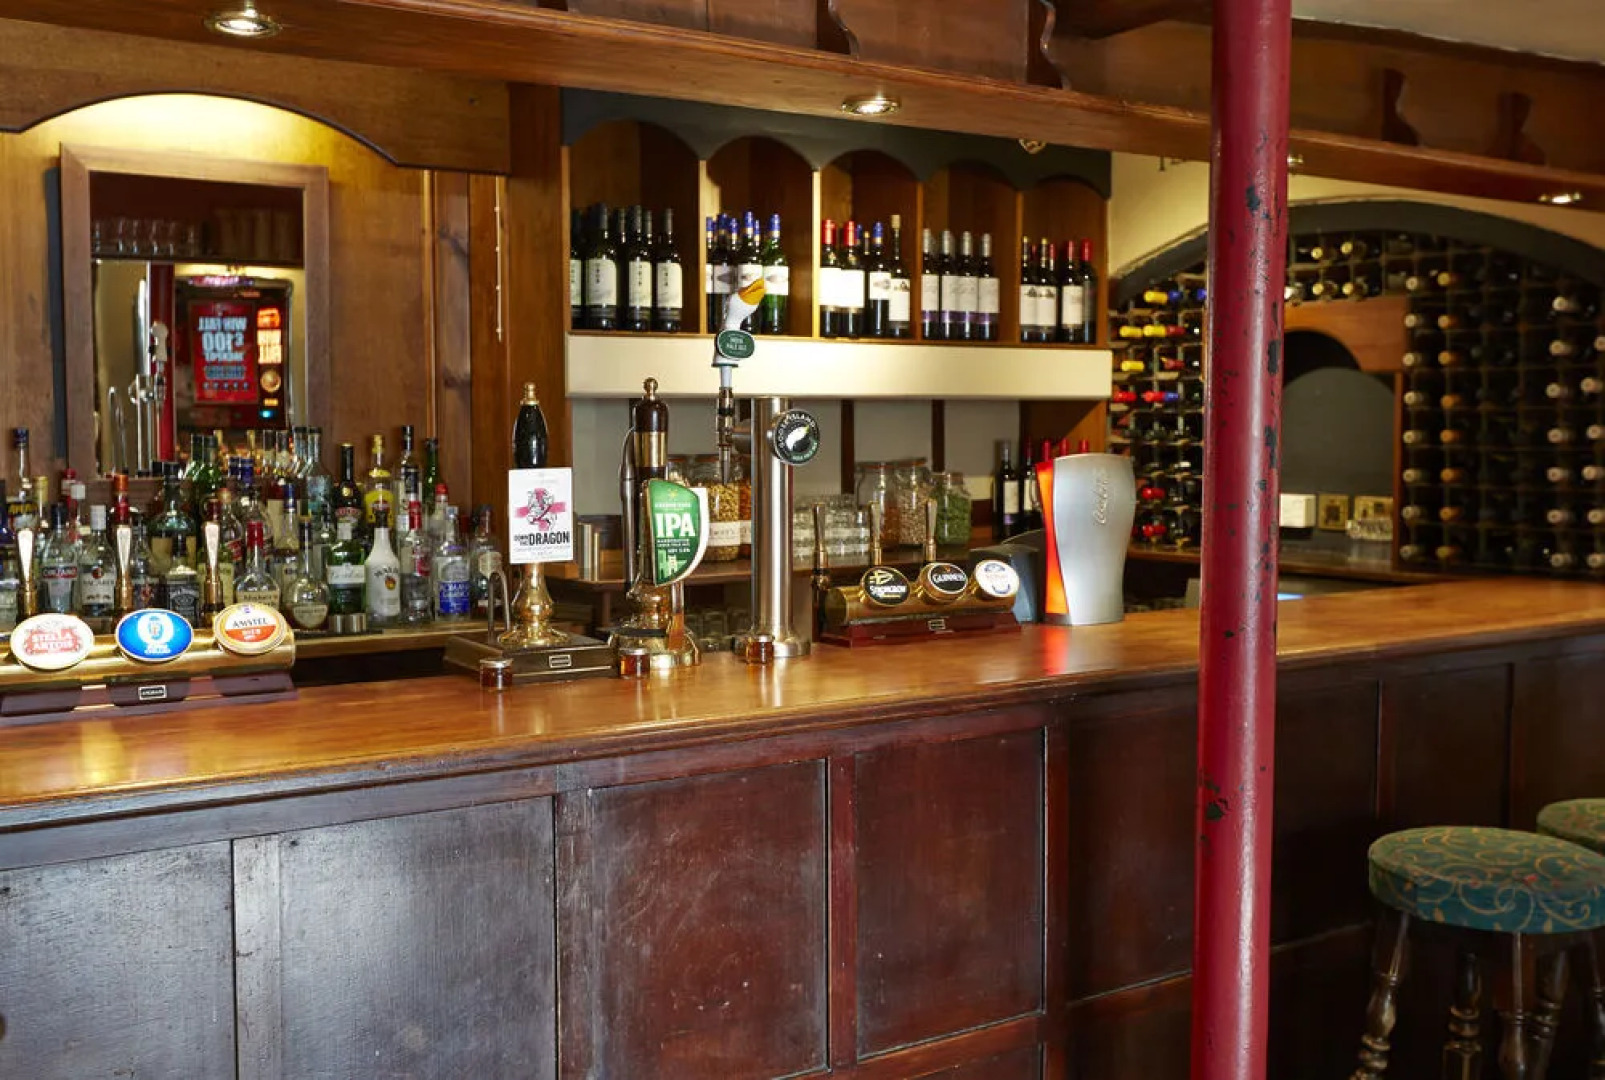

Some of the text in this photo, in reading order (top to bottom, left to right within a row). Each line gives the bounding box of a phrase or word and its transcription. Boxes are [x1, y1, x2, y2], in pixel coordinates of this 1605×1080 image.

[655, 512, 696, 538] IPA
[528, 531, 570, 546] DRAGON
[233, 617, 268, 629] AMSTEL
[31, 630, 73, 642] STELLA
[33, 639, 74, 649] ARTOIS
